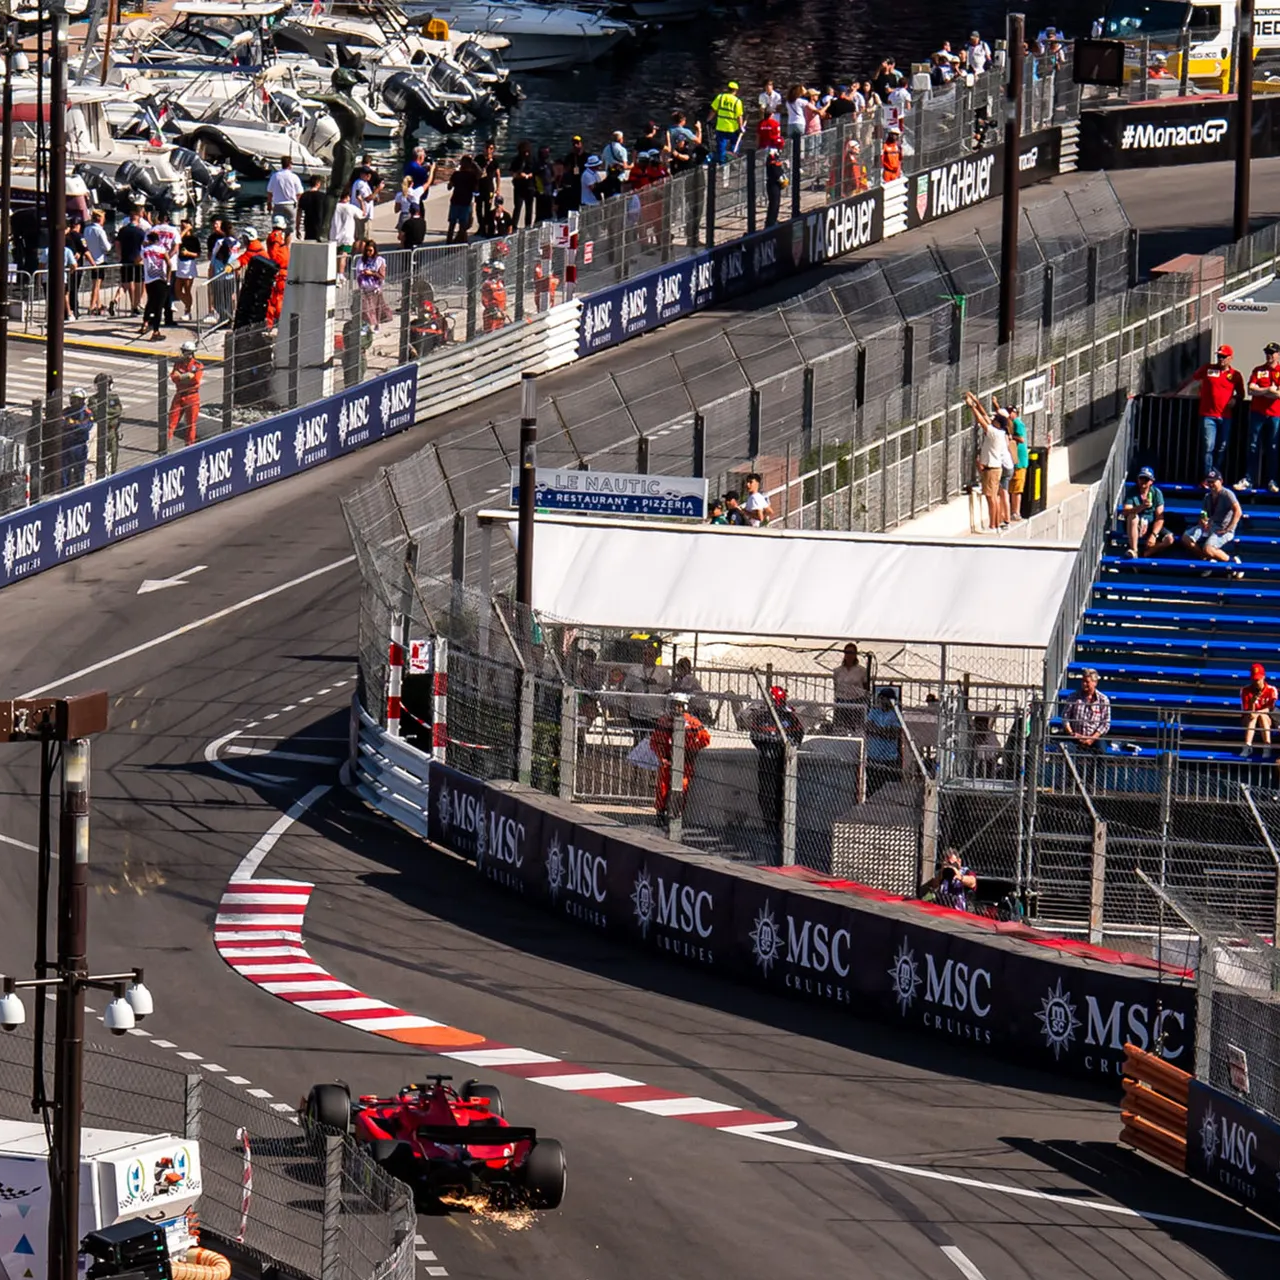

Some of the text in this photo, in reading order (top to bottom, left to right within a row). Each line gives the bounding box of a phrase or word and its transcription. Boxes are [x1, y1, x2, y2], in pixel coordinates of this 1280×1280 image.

[1122, 120, 1227, 149] #MonacoGP
[629, 288, 647, 318] MSC
[664, 274, 682, 304] MSC
[593, 301, 611, 333] MSC
[348, 396, 369, 429] MSC
[391, 380, 412, 413] MSC
[257, 431, 281, 466] MSC
[305, 414, 328, 449] MSC
[209, 448, 232, 484] MSC
[115, 483, 138, 519] MSC
[162, 466, 185, 502] MSC
[555, 475, 661, 495] LE NAUTIC
[557, 495, 693, 508] RESTAURANT PIZZERIA
[66, 503, 91, 538] MSC
[16, 521, 41, 557] MSC
[489, 811, 524, 867] MSC
[567, 845, 606, 902] MSC
[657, 878, 712, 937] MSC
[786, 916, 850, 976] MSC
[925, 953, 990, 1016] MSC
[924, 1013, 990, 1040] CRUISES
[1086, 996, 1186, 1059] MSC
[1221, 1117, 1257, 1174] MSC
